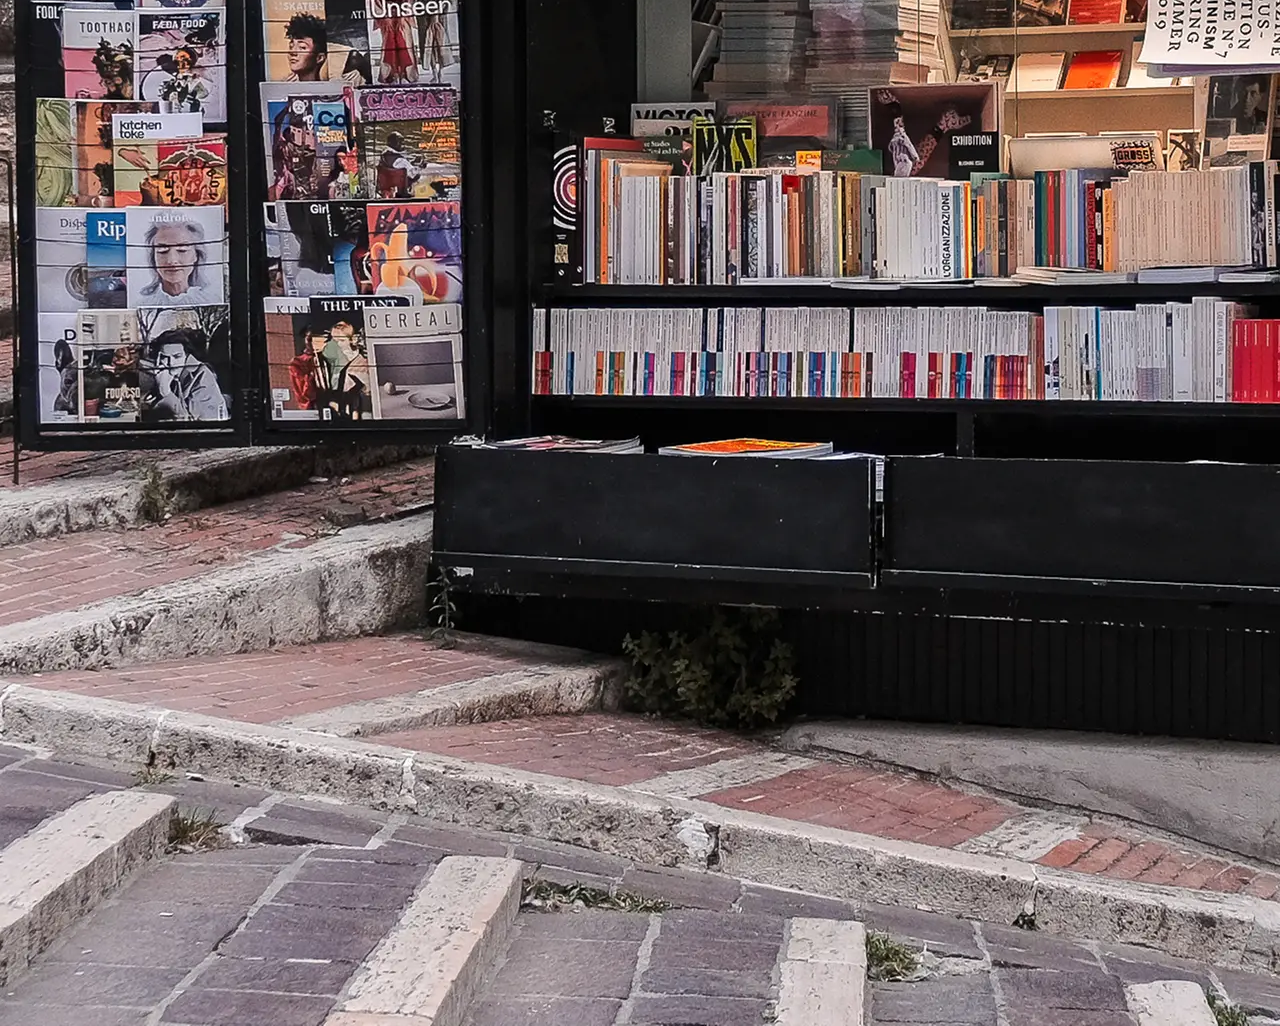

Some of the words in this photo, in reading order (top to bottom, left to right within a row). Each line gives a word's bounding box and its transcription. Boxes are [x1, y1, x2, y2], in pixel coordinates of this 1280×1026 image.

[180, 18, 206, 29] FOOD
[366, 91, 437, 109] CACCIA
[119, 120, 162, 131] kitchen
[120, 129, 145, 139] toke
[952, 134, 993, 146] EXHIBITION
[1117, 149, 1151, 161] GROSS
[97, 220, 126, 241] Rip
[941, 191, 952, 278] L'ORGANIZZAZIONE
[321, 300, 349, 312] THE
[353, 298, 398, 312] PLANT
[370, 310, 452, 329] CEREAL
